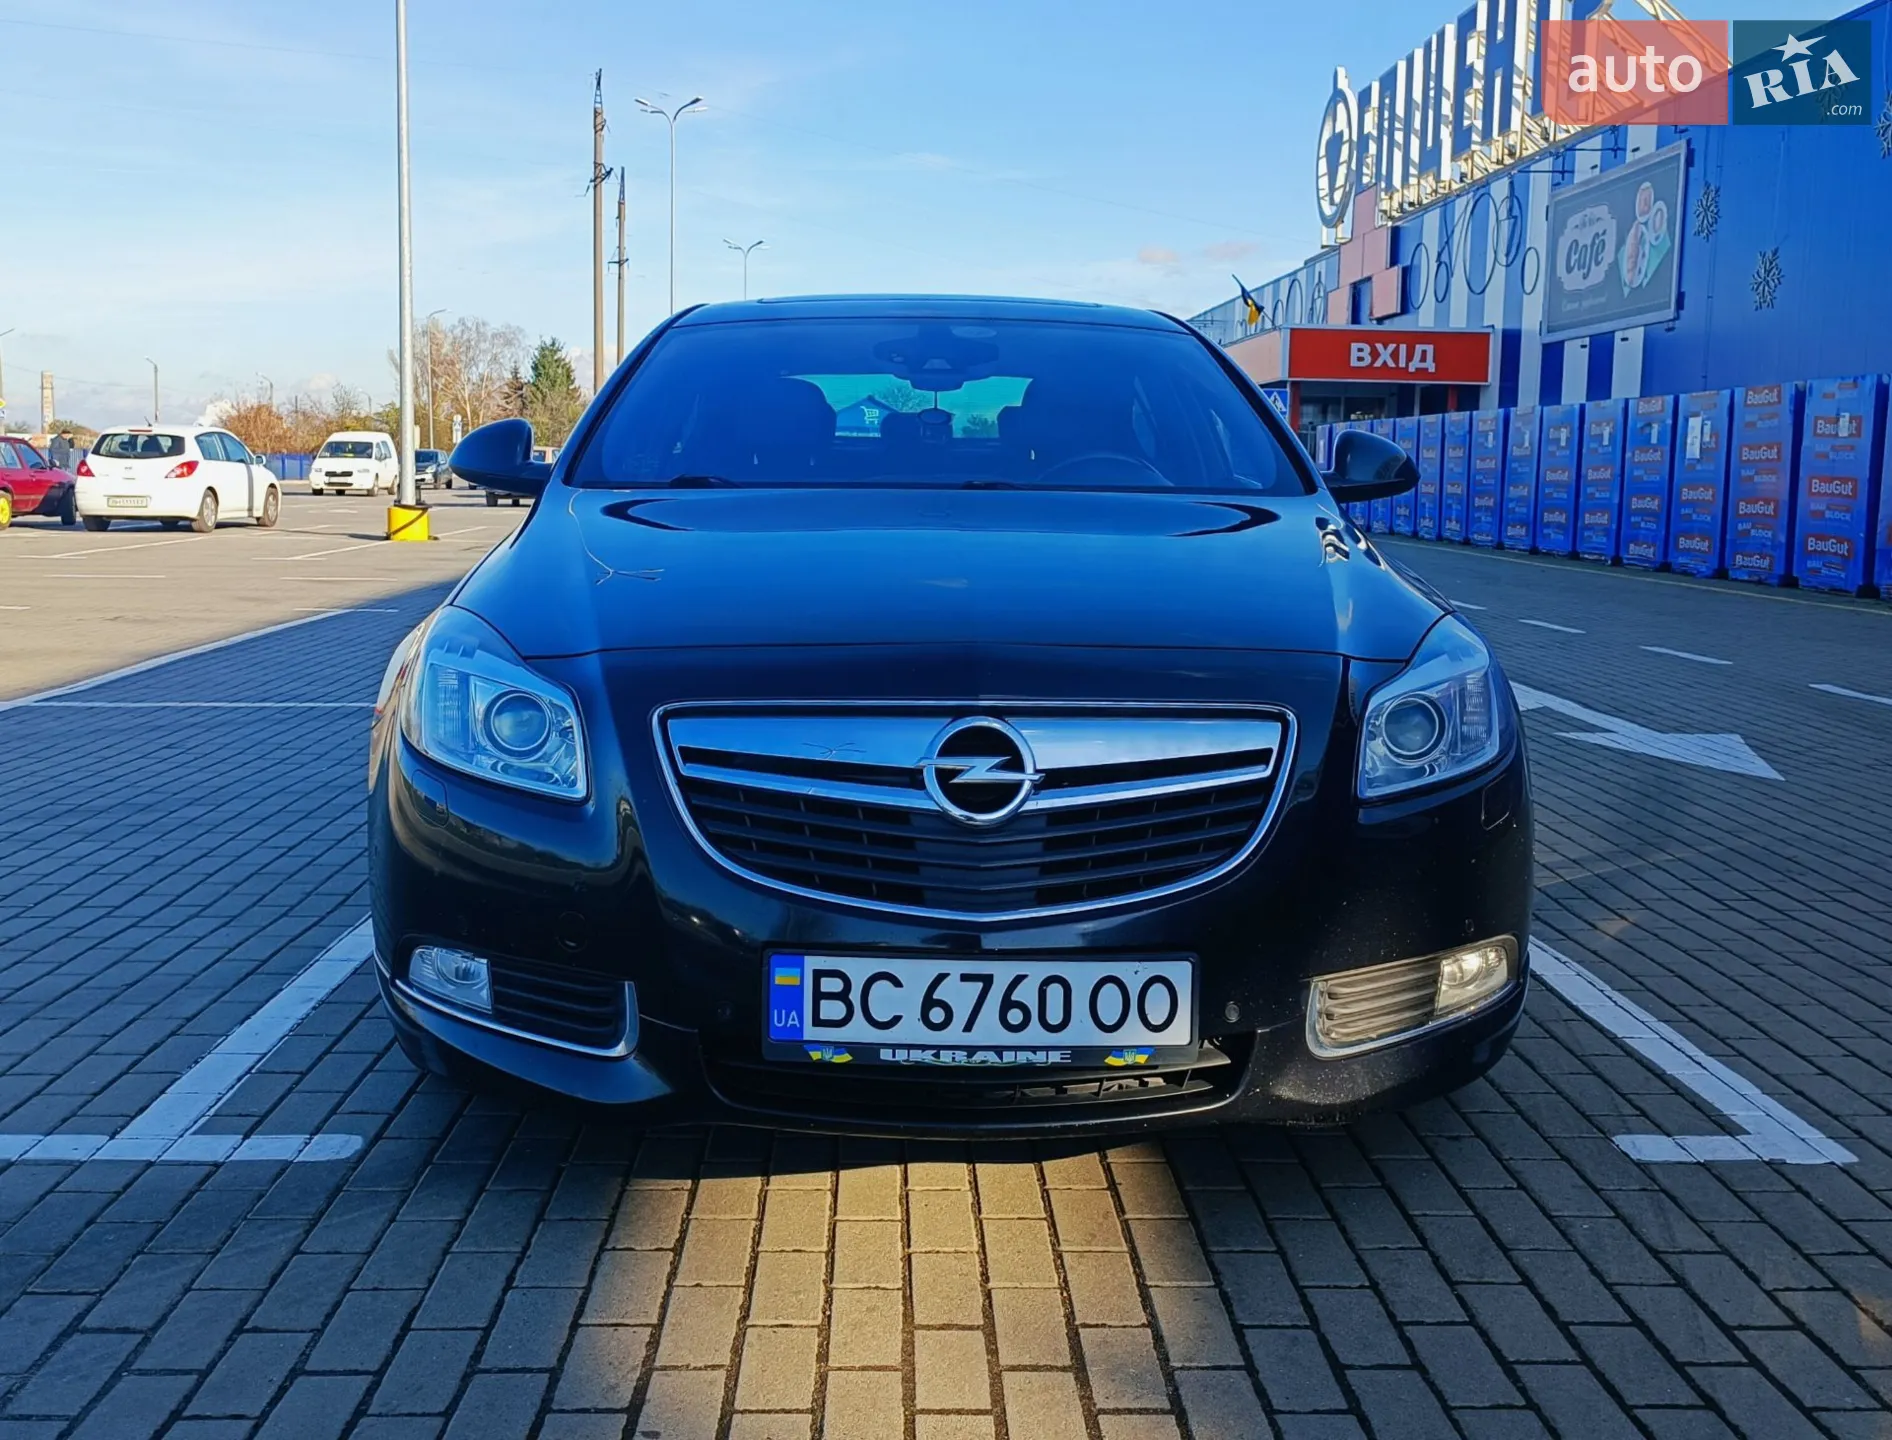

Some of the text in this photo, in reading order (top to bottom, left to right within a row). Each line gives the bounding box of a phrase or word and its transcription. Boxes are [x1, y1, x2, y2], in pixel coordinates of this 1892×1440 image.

[1565, 228, 1608, 281] Café
[1350, 342, 1436, 373] ВХІД
[1816, 419, 1858, 435] Bauut
[1742, 445, 1778, 461] BauGut
[1681, 487, 1713, 501] BauGut
[1811, 479, 1853, 496] BauGut
[1738, 501, 1775, 516] BauGut
[1678, 537, 1710, 552] BauGut
[1807, 537, 1849, 556] BauGut
[1735, 554, 1771, 570] BauGut
[810, 968, 1180, 1035] BC 6760 OO
[773, 1008, 801, 1029] UA
[878, 1048, 1073, 1065] UKRAINE
